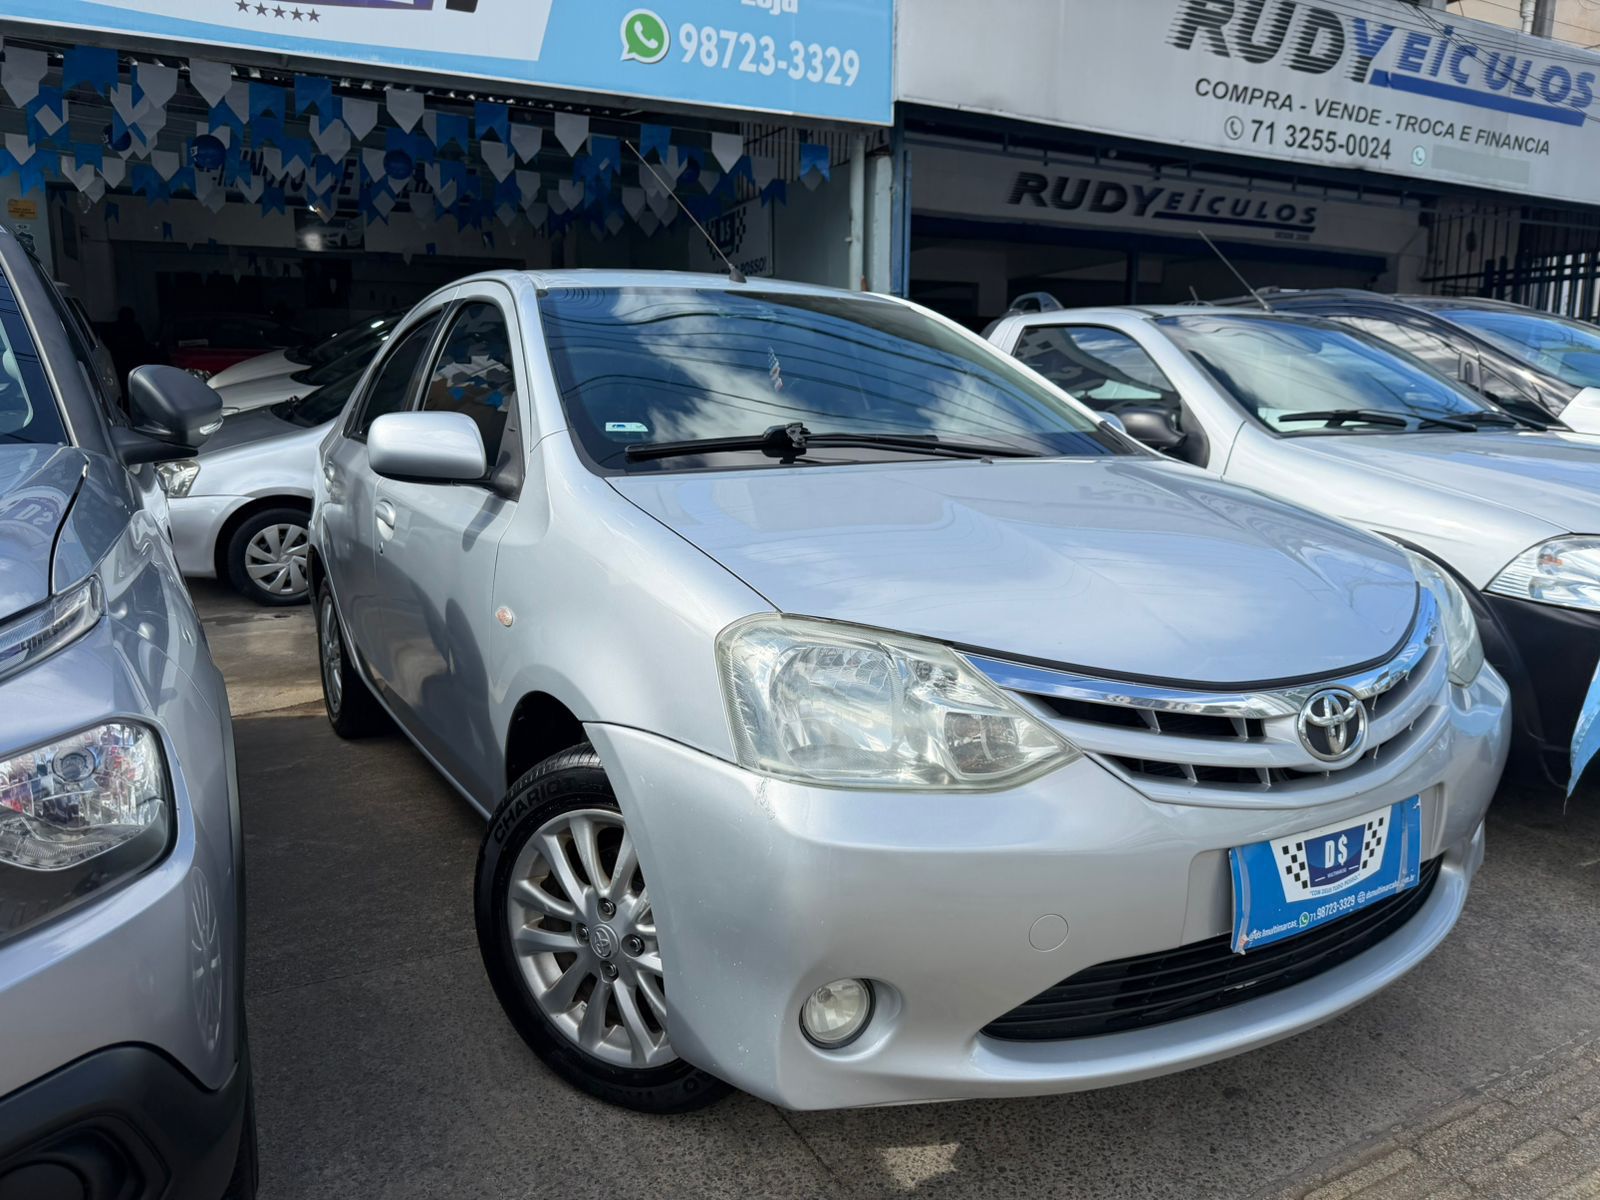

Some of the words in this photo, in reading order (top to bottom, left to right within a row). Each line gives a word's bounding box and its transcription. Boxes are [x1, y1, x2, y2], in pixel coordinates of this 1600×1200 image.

[678, 22, 860, 87] 98723-3329
[1195, 77, 1294, 112] COMPRA
[1314, 97, 1382, 127] VENDE
[1395, 113, 1456, 139] TROCA
[1459, 125, 1473, 142] E
[1475, 128, 1551, 156] FINANCIA
[1250, 118, 1276, 146] 71
[1284, 124, 1392, 161] 3255-0024
